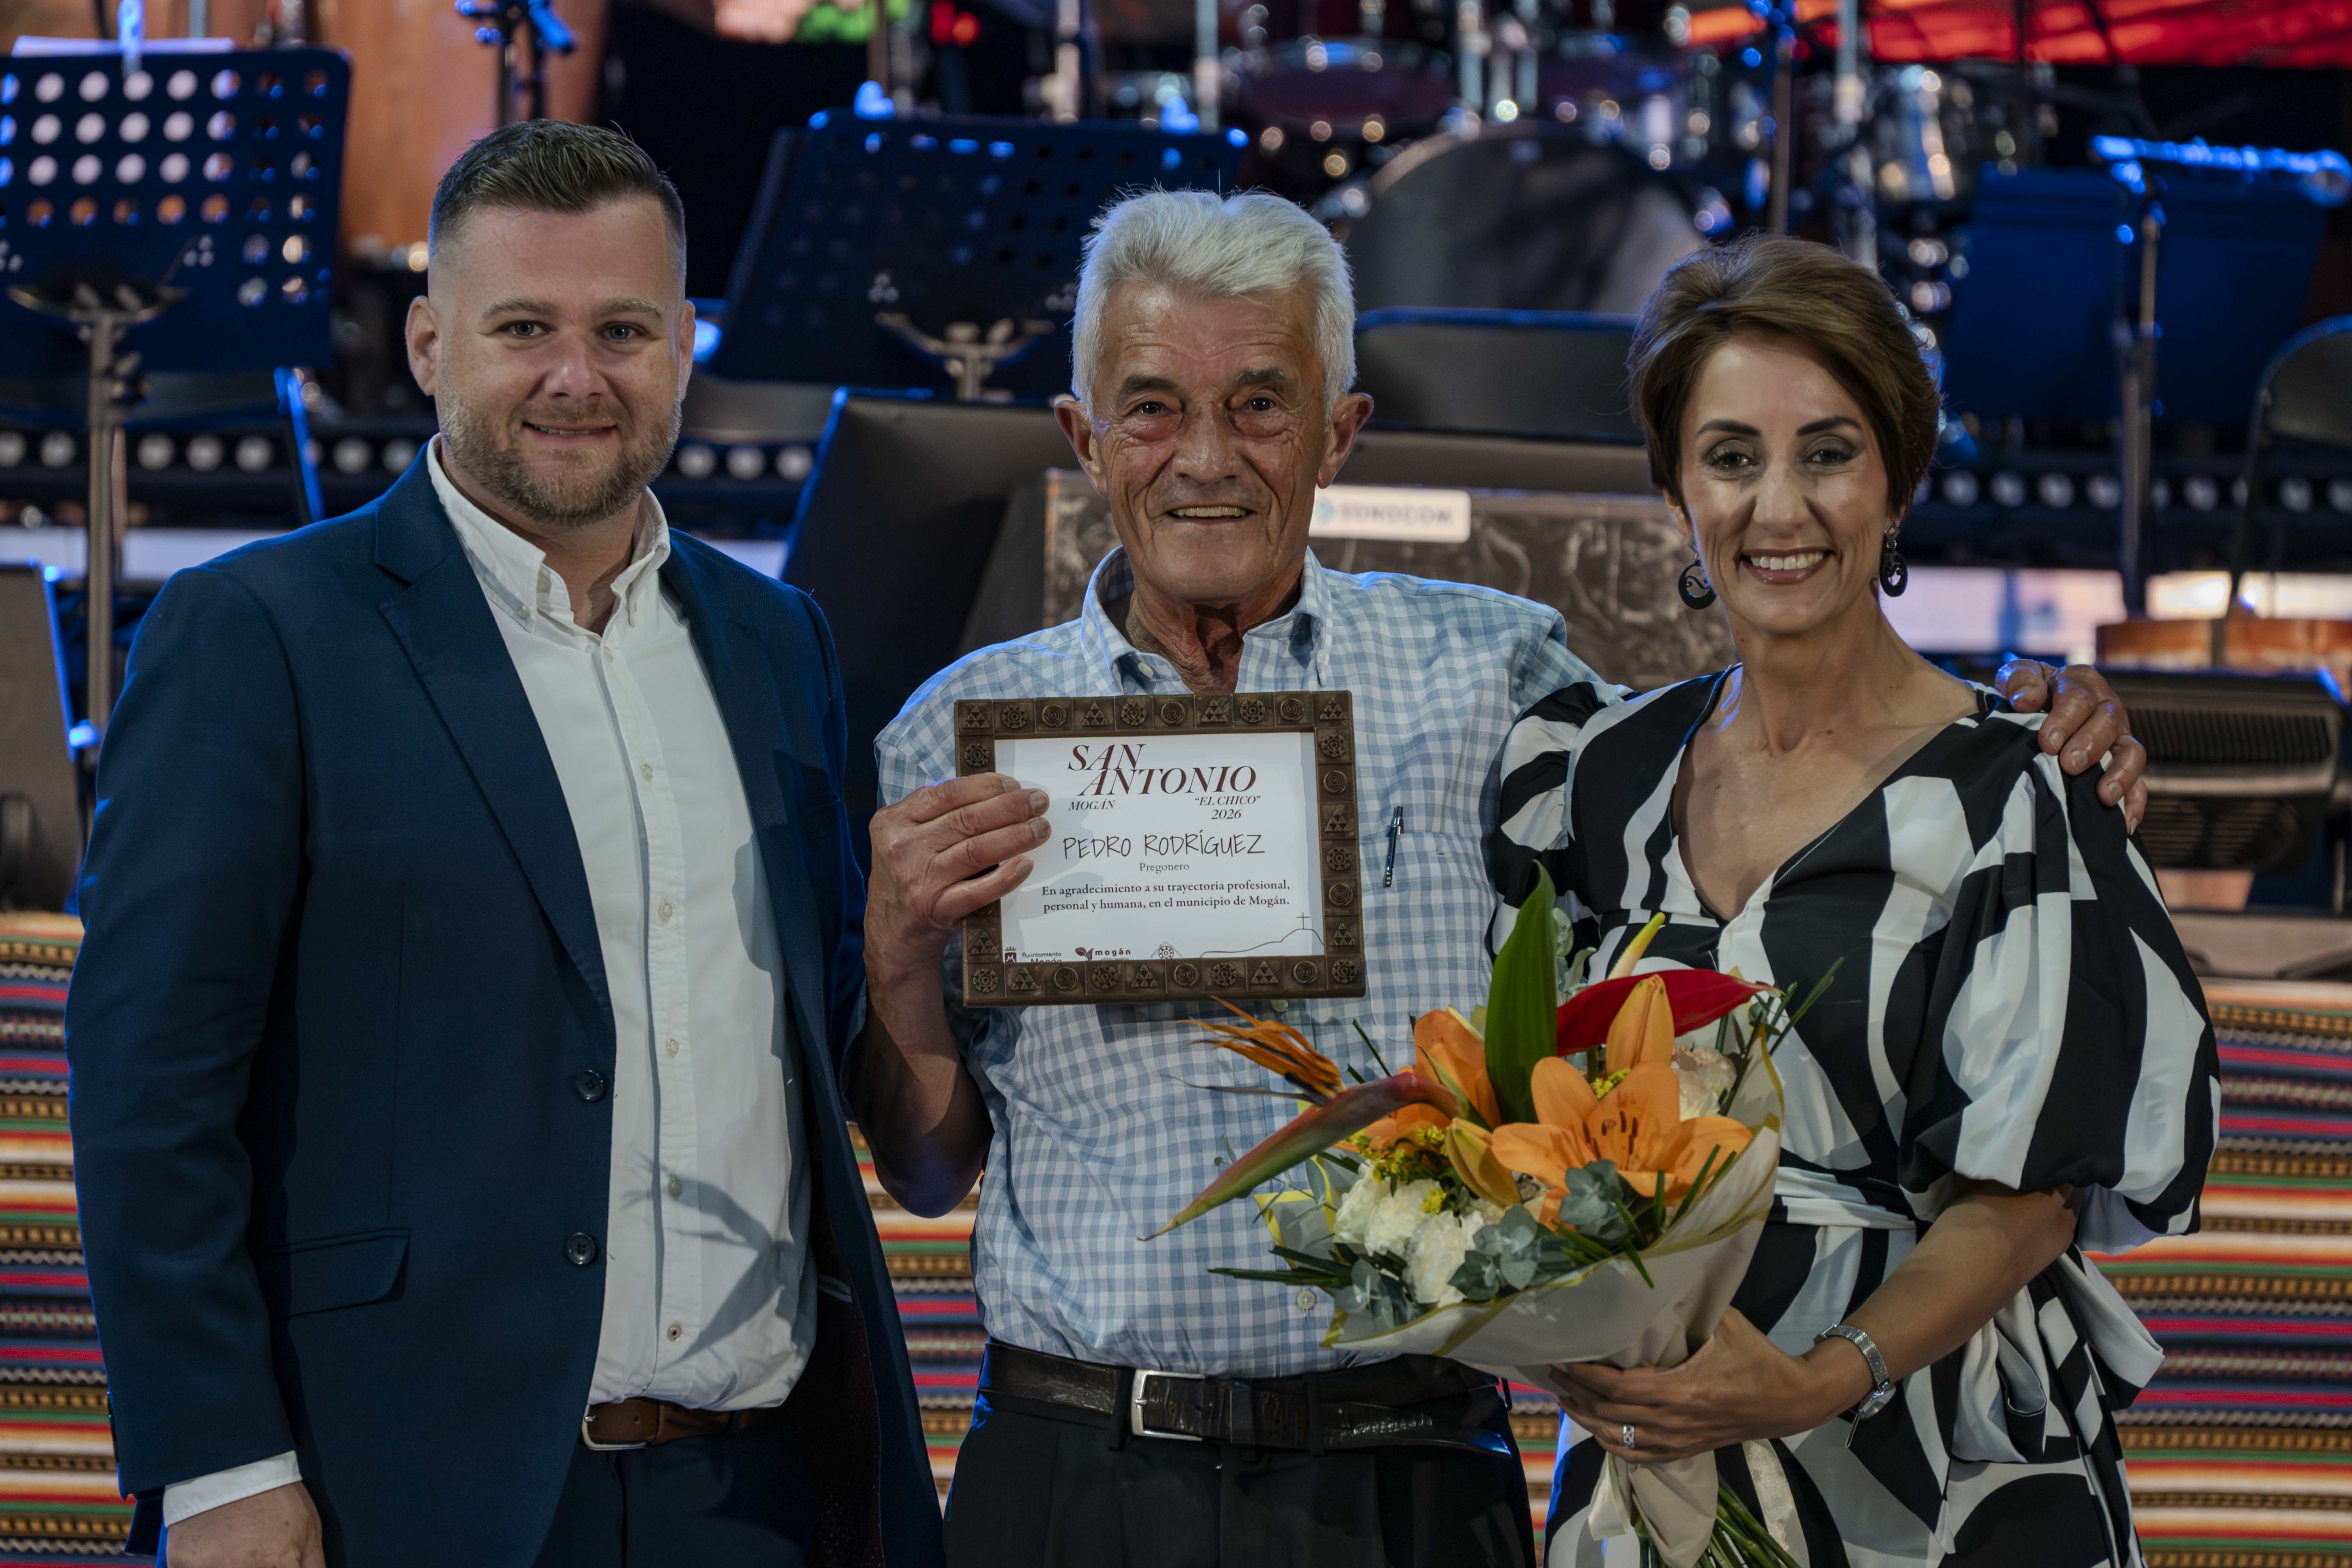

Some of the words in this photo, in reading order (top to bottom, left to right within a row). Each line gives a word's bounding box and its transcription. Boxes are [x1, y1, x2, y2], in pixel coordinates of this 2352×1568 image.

[1068, 744, 1146, 771] SAN
[1076, 766, 1256, 796] ANTONIO
[1068, 798, 1115, 811] MOGÁN
[1211, 809, 1242, 820] 2026
[1063, 836, 1131, 860] PEDRO
[1144, 830, 1265, 857] RODRÍGUEZ
[1140, 862, 1189, 874] Pregonero
[1042, 886, 1056, 895] En
[1060, 884, 1142, 898] agradecimiento
[1168, 882, 1224, 893] trayectoria
[1228, 879, 1290, 893] profesional,
[1043, 900, 1088, 914] personal
[1091, 903, 1097, 912] y
[1100, 899, 1146, 909] humana,
[1164, 897, 1173, 907] el
[1176, 897, 1230, 909] municipio
[1234, 895, 1246, 905] de
[1249, 896, 1289, 908] Mogán.
[1095, 948, 1131, 957] mogán
